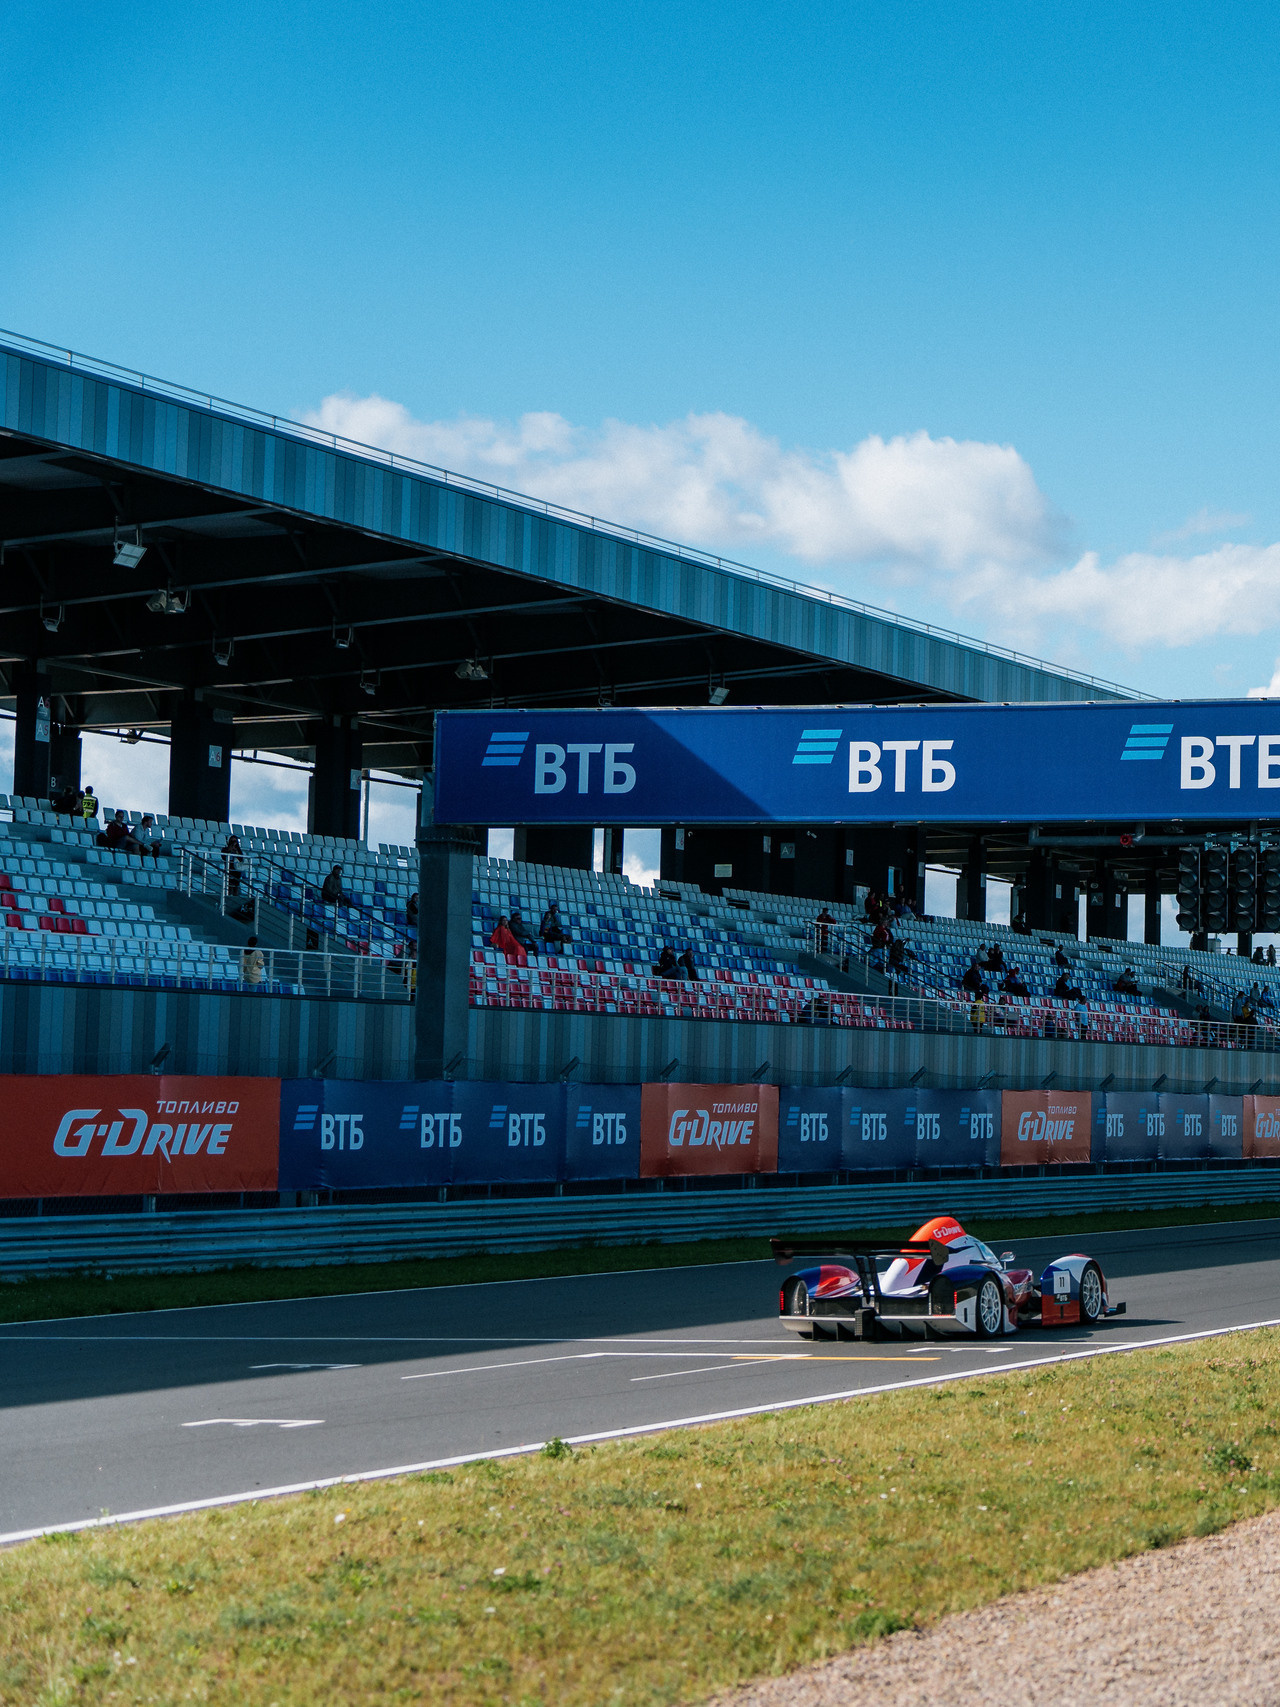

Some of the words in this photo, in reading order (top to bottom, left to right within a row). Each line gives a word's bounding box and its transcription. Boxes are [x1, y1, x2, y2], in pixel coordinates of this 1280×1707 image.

[535, 742, 636, 794] ВТБ
[849, 739, 956, 792] ВТБ
[156, 1100, 240, 1114] ТОПЛИВО
[712, 1103, 758, 1114] ТОПЛИВО
[1047, 1106, 1077, 1115] ТОПЛИВО
[320, 1113, 364, 1150] ВТБ
[420, 1113, 463, 1148] ВТБ
[508, 1113, 546, 1146] ВТБ
[592, 1112, 627, 1144] ВТБ
[800, 1113, 829, 1142] ВТБ
[861, 1113, 888, 1141] ВТБ
[917, 1113, 941, 1140] ВТБ
[970, 1113, 994, 1139] ВТБ
[1106, 1113, 1124, 1137] ВТБ
[1147, 1113, 1166, 1137] ВТБ
[1184, 1113, 1202, 1137] ВТБ
[1221, 1114, 1238, 1137] ВТБ
[1059, 1276, 1065, 1288] 11
